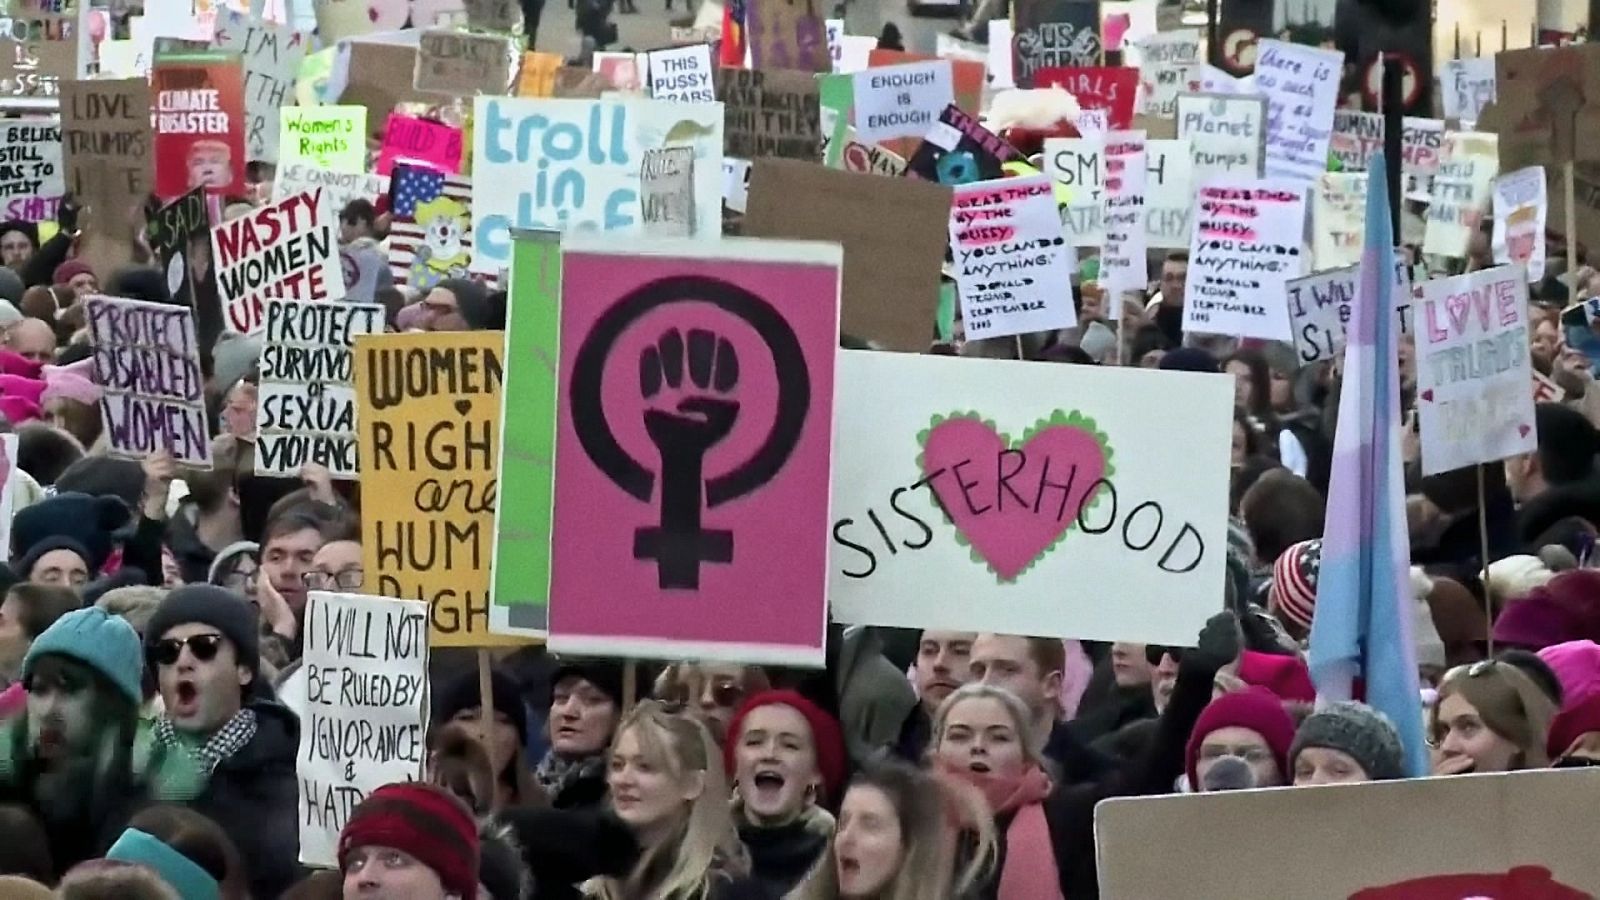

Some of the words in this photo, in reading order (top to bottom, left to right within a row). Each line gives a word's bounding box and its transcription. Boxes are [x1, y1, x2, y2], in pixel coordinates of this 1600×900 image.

[661, 56, 699, 73] THIS
[244, 71, 287, 108] ITH
[655, 73, 708, 92] PUSSY
[871, 72, 936, 89] ENOUGH
[1068, 74, 1118, 101] IRLS
[72, 93, 138, 120] LOVE
[159, 89, 220, 111] CLIMATE
[896, 92, 912, 106] IS
[159, 112, 229, 134] DISASTER
[485, 99, 628, 165] troll
[868, 111, 932, 128] ENOUGH
[1185, 112, 1254, 138] Planet
[7, 127, 62, 143] BELIEV
[67, 129, 145, 158] TRUMPS
[32, 162, 54, 177] TO
[535, 158, 585, 209] in
[0, 180, 43, 197] TEST
[5, 196, 63, 221] SHIT
[982, 208, 1013, 221] THE
[1231, 205, 1259, 217] THE
[215, 187, 322, 268] NASTY
[960, 246, 997, 264] YOU
[1197, 239, 1233, 252] YOU
[219, 226, 330, 301] WOMEN
[970, 300, 1047, 318] SEPTEMBER
[1290, 288, 1306, 317] I
[88, 300, 188, 357] PROTECT
[267, 301, 381, 347] PROTECT
[93, 347, 202, 400] DISABLED
[262, 346, 353, 381] SURVIVO
[260, 396, 354, 431] SEXUA
[103, 396, 207, 461] WOMEN
[371, 420, 491, 471] RIGH
[832, 448, 1205, 579] SISTERHOOD
[375, 520, 480, 572] HUM
[308, 599, 315, 651] I
[324, 602, 377, 658] WILL
[384, 606, 425, 661] NOT
[307, 664, 337, 706] BE
[340, 667, 391, 708] RULED
[393, 674, 422, 707] BY
[308, 713, 420, 763] IGNORANCE
